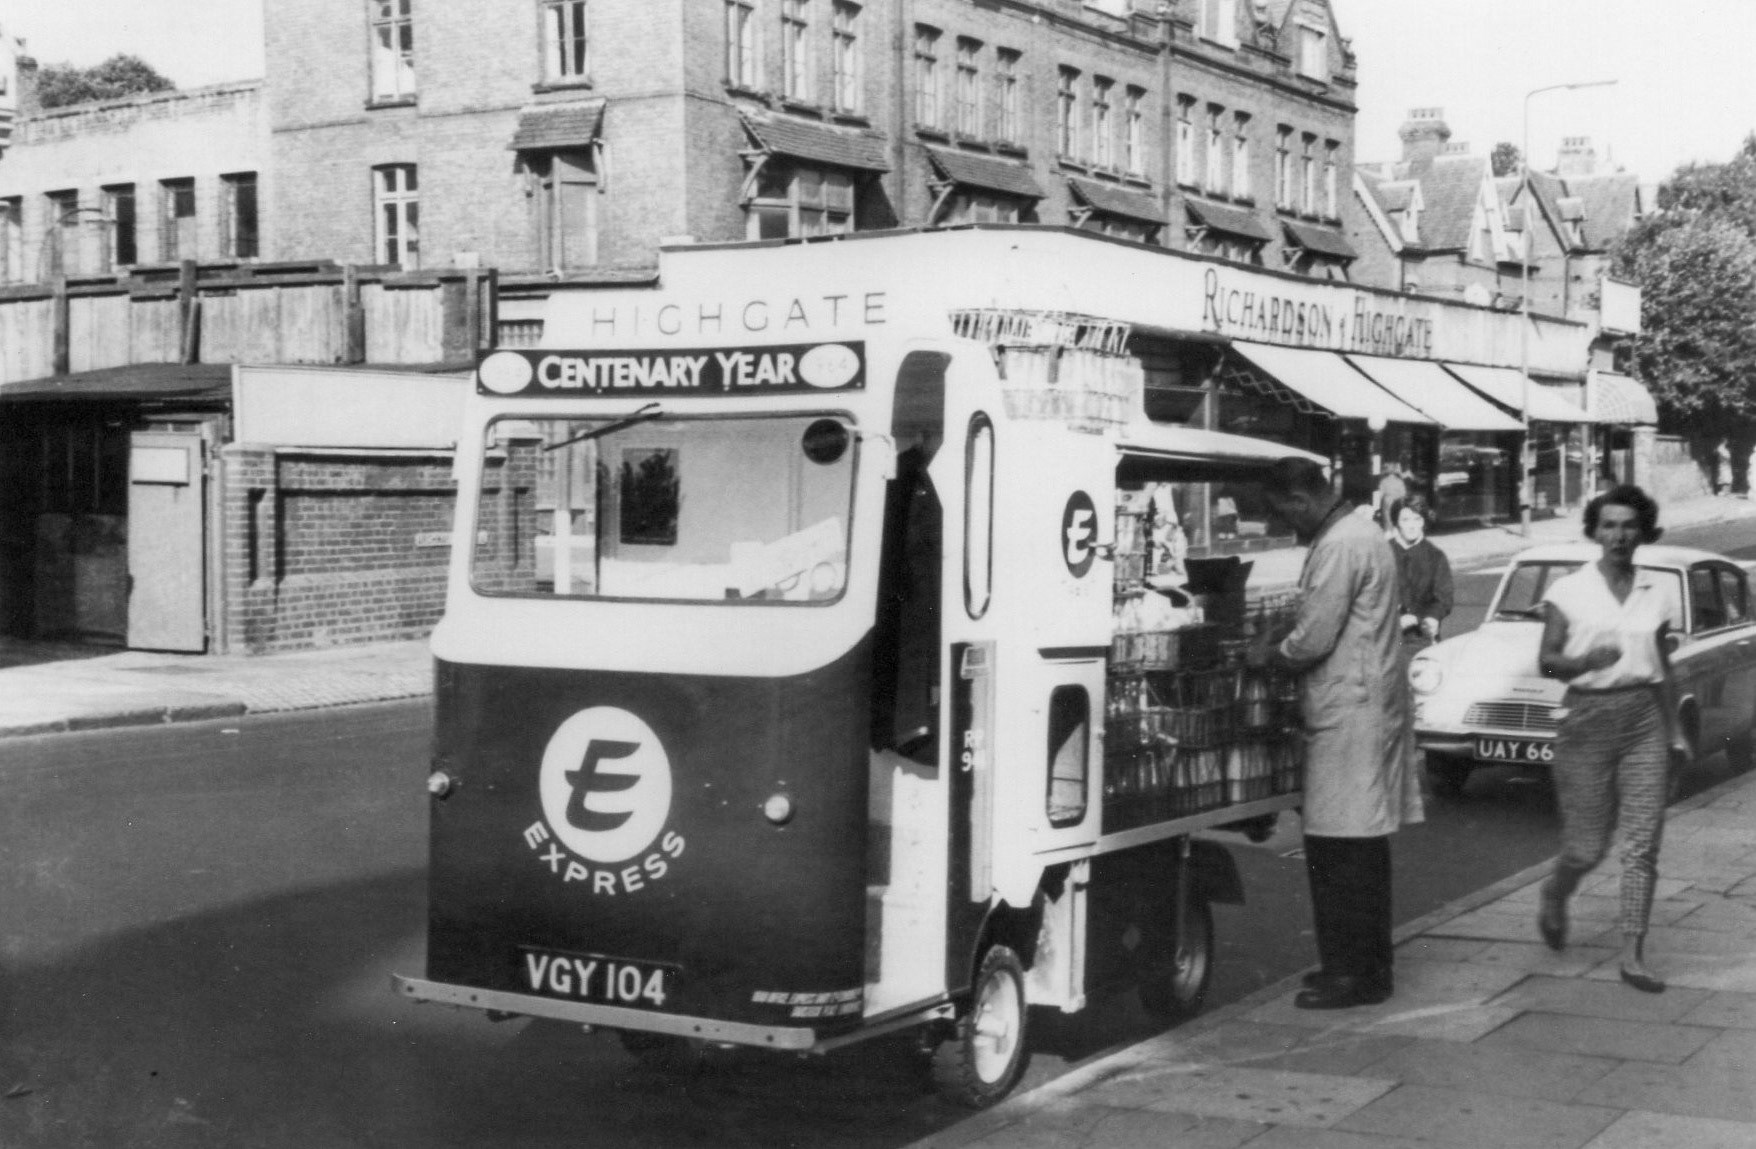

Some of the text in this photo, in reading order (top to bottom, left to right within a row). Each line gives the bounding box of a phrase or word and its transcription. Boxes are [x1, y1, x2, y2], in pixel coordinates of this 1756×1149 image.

[591, 291, 887, 337] HIGHGATE
[1203, 268, 1332, 340] RICHARDSON
[1351, 296, 1433, 349] HIGHGATE
[537, 354, 708, 389] CENTENARY
[715, 351, 797, 386] YEAR
[1479, 739, 1554, 761] UAY 66
[564, 738, 642, 833] E
[522, 820, 686, 896] EXPRESS
[525, 953, 667, 1006] VGY 104
